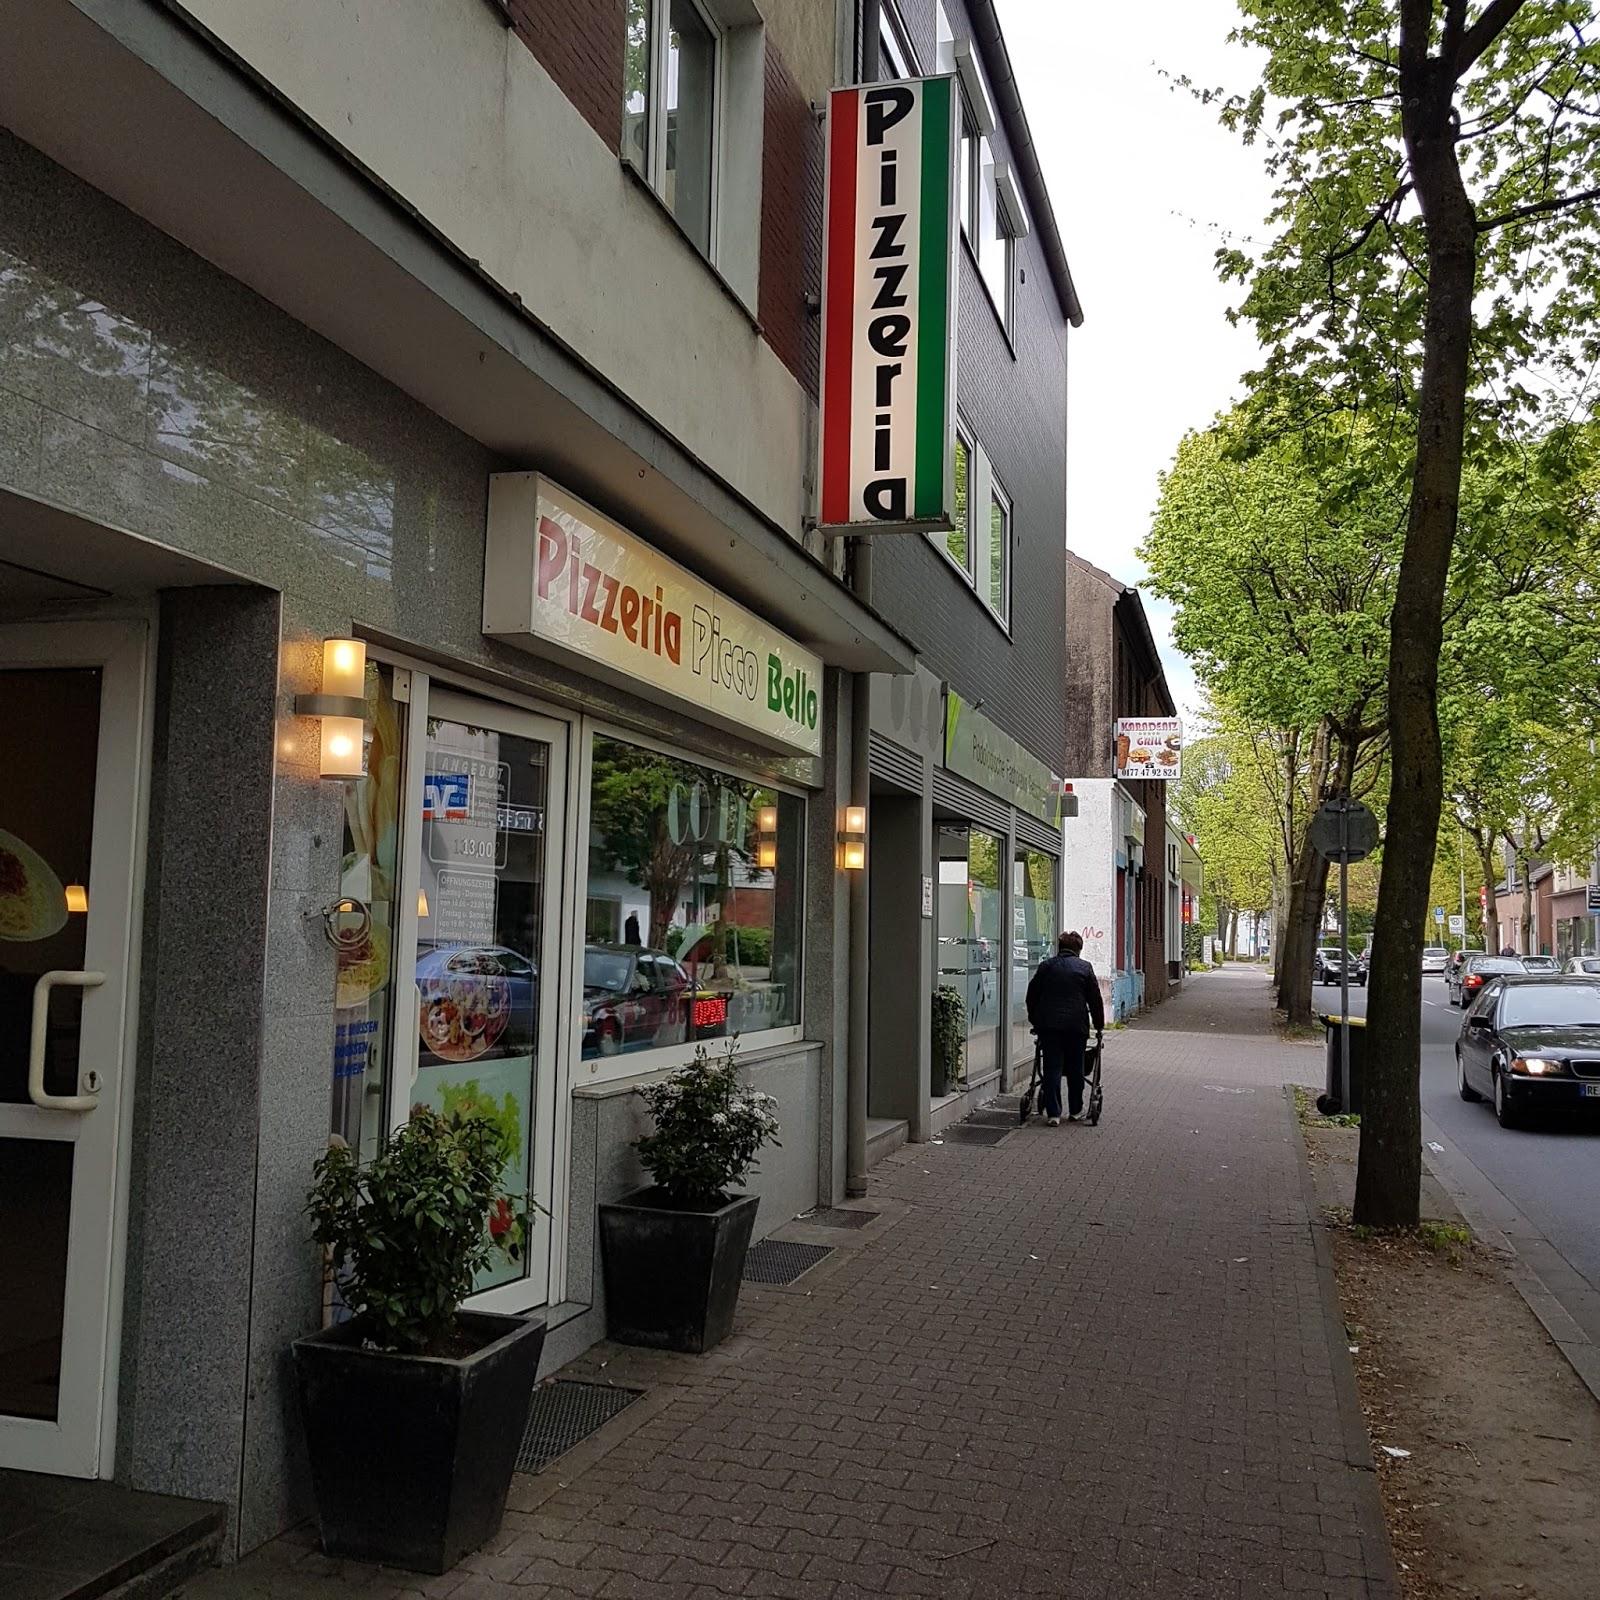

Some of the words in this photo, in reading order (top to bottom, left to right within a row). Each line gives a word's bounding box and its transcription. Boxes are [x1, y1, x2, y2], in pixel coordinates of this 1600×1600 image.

[863, 87, 914, 520] Pizzeria
[537, 515, 682, 665] Pizzeria
[691, 604, 759, 701] Picco
[767, 652, 817, 730] Bello
[441, 757, 503, 780] ANGEBOT
